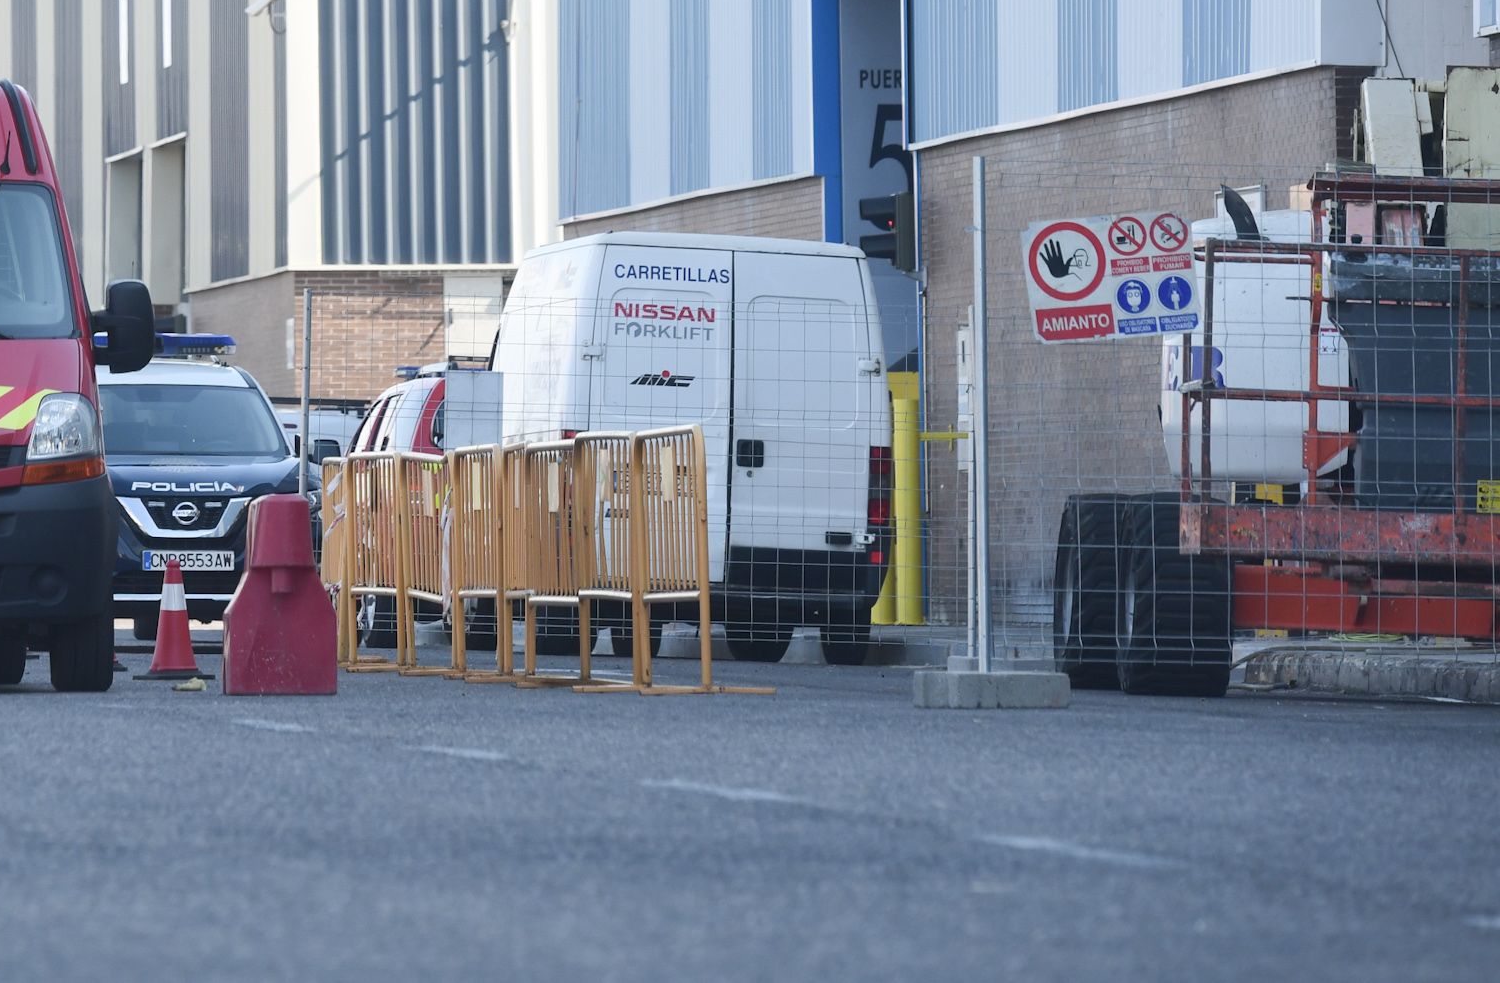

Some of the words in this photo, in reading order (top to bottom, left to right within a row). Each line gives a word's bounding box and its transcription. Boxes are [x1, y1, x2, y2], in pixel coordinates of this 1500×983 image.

[869, 104, 915, 231] 5
[1117, 258, 1143, 267] PROHIBIDO
[1152, 254, 1191, 264] PROHIBIDO
[1160, 261, 1185, 270] FUMAR
[614, 264, 730, 284] CARRETILLAS
[614, 302, 715, 323] NISSAN
[614, 321, 715, 341] FORKLIFT
[1042, 313, 1110, 333] AMIANTO
